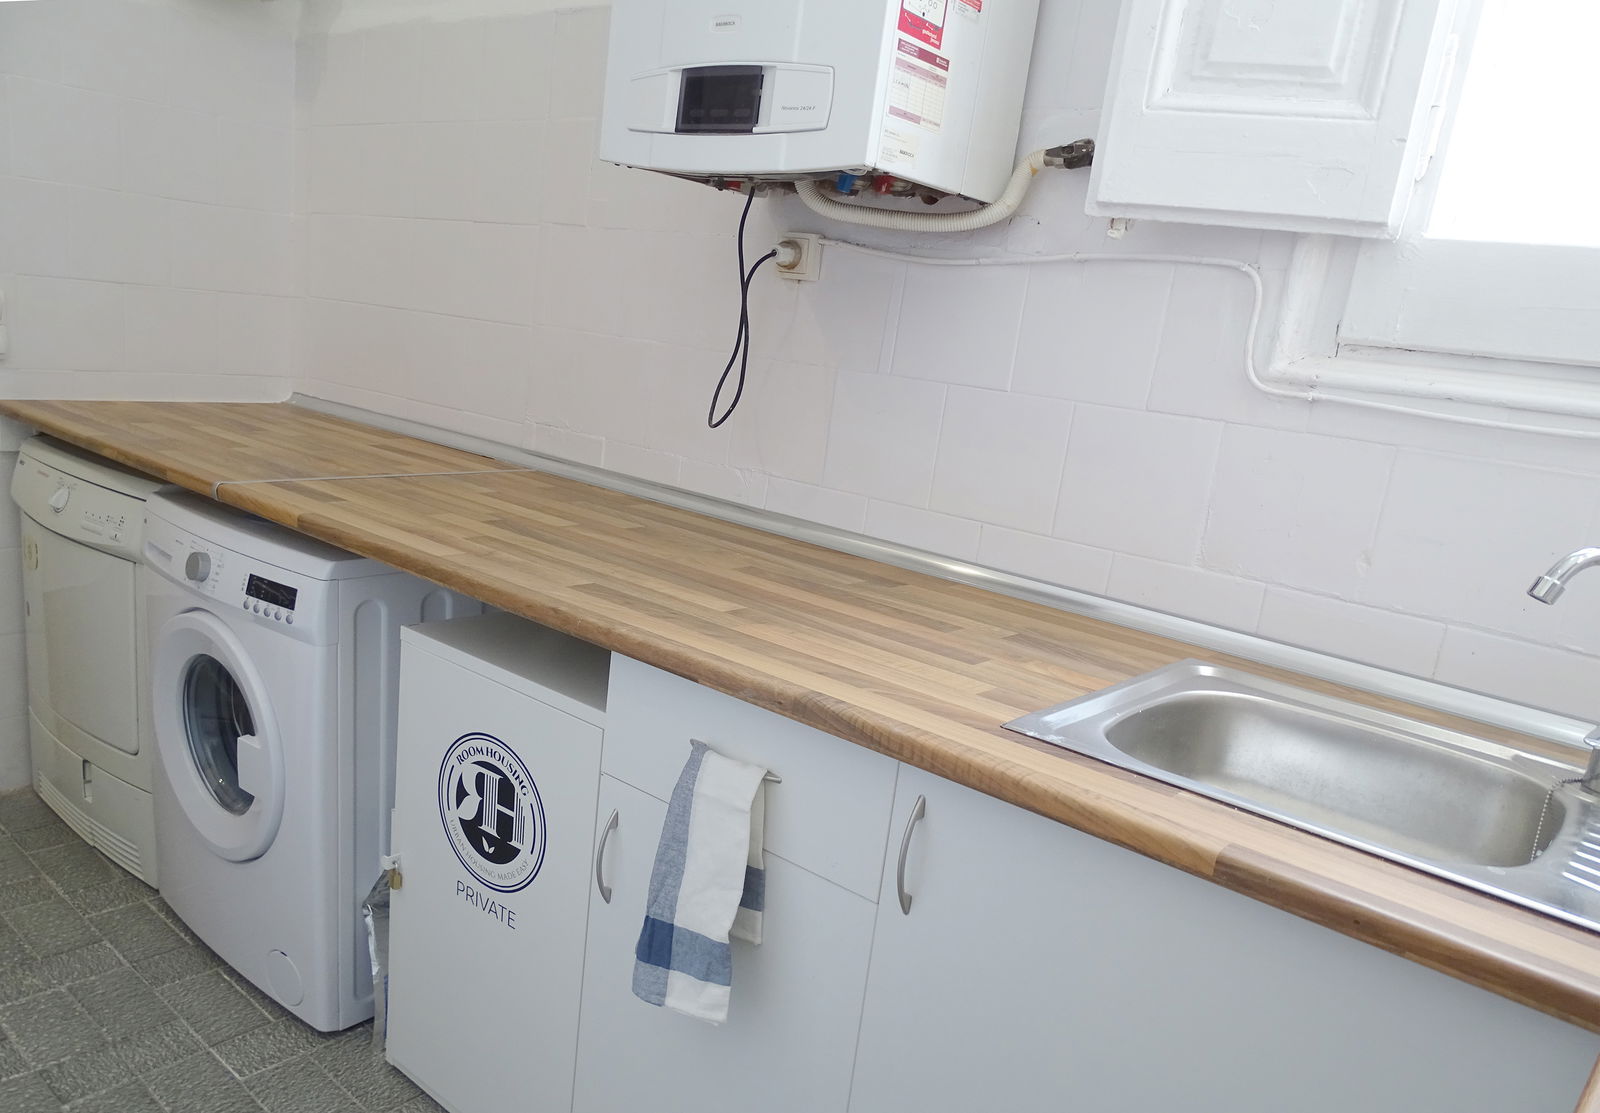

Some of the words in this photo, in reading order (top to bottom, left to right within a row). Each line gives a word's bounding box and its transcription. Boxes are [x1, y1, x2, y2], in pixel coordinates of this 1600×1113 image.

[456, 745, 485, 765] ROOM
[485, 746, 530, 797] HOUSING
[465, 851, 497, 879] HOUSING
[496, 871, 517, 881] MADE
[516, 859, 530, 876] EASY
[456, 880, 517, 930] PRIVATE
